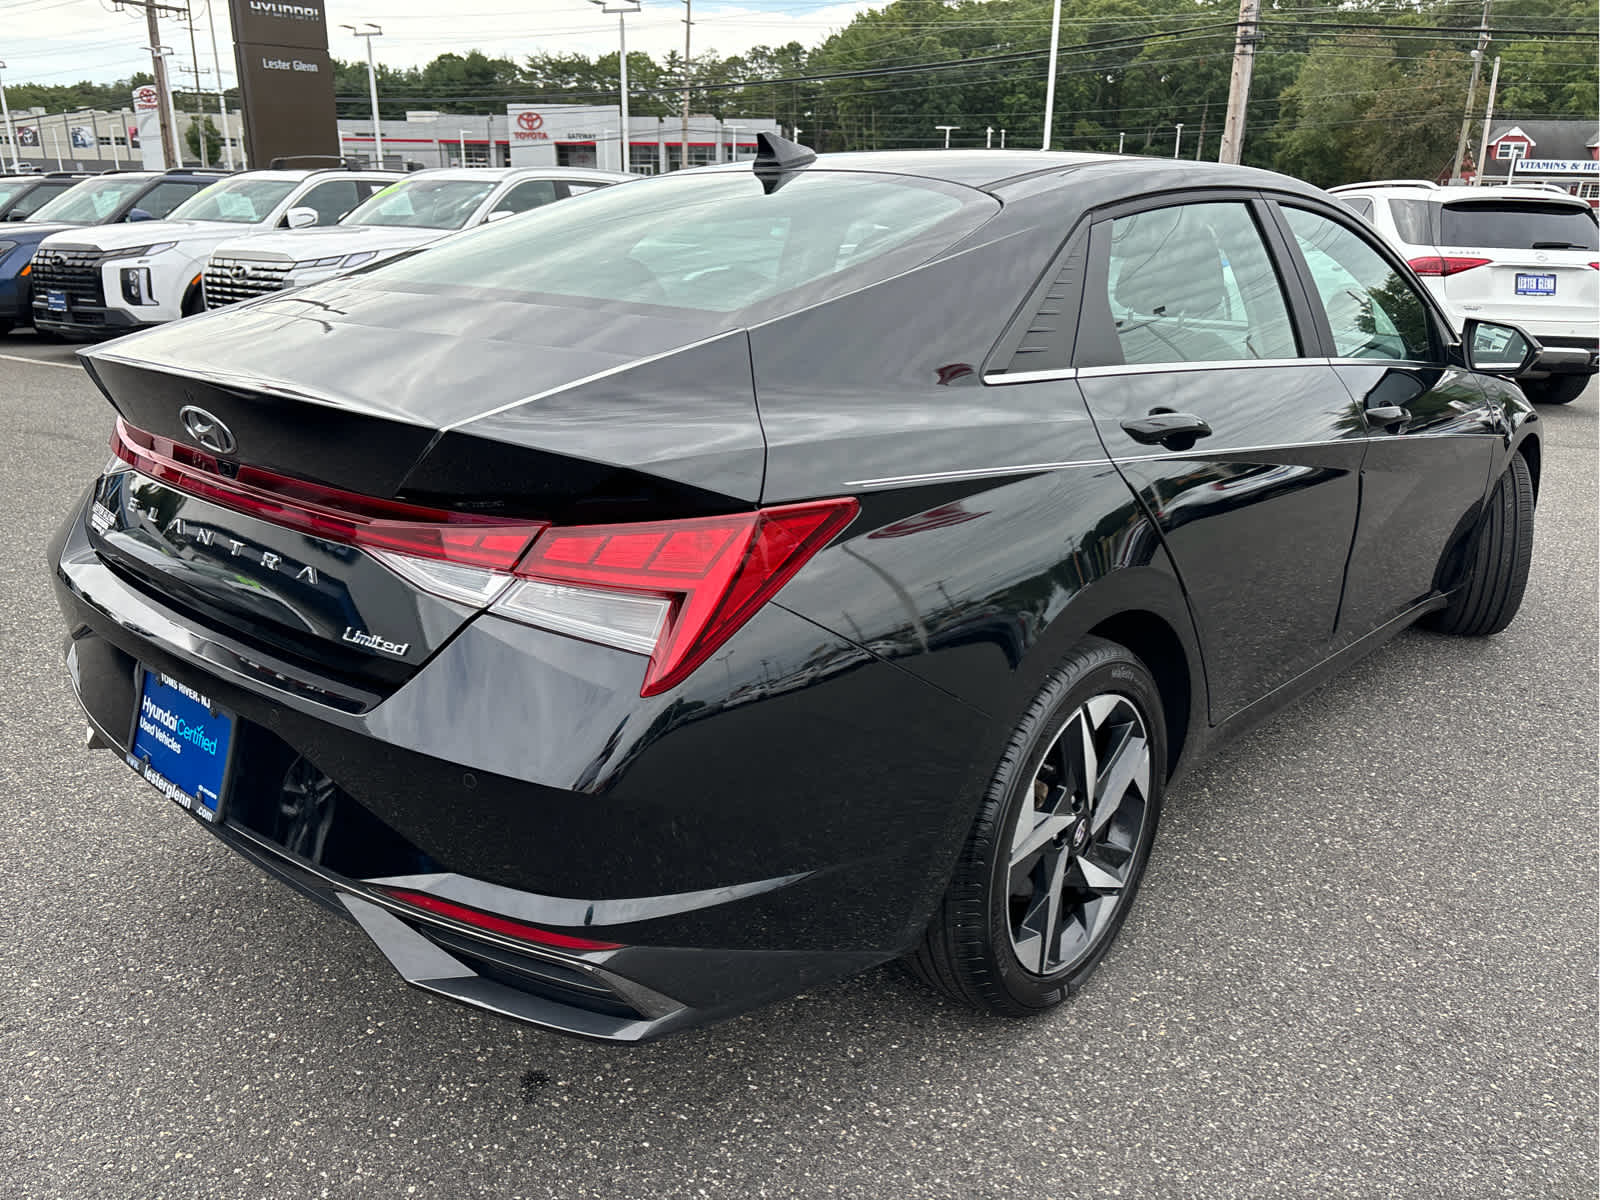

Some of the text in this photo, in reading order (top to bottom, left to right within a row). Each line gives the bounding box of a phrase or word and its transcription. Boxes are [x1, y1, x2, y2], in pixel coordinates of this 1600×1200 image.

[263, 57, 319, 73] Lester Glenn
[513, 131, 548, 140] TOYOTA
[1520, 161, 1567, 169] VITAMINS
[1570, 162, 1580, 170] &
[128, 496, 321, 586] ELANTRA
[342, 626, 409, 656] Limited
[201, 694, 211, 709] NJ
[139, 715, 156, 737] Used
[155, 725, 182, 755] Vehicles
[142, 695, 218, 756] Hyundai Certified
